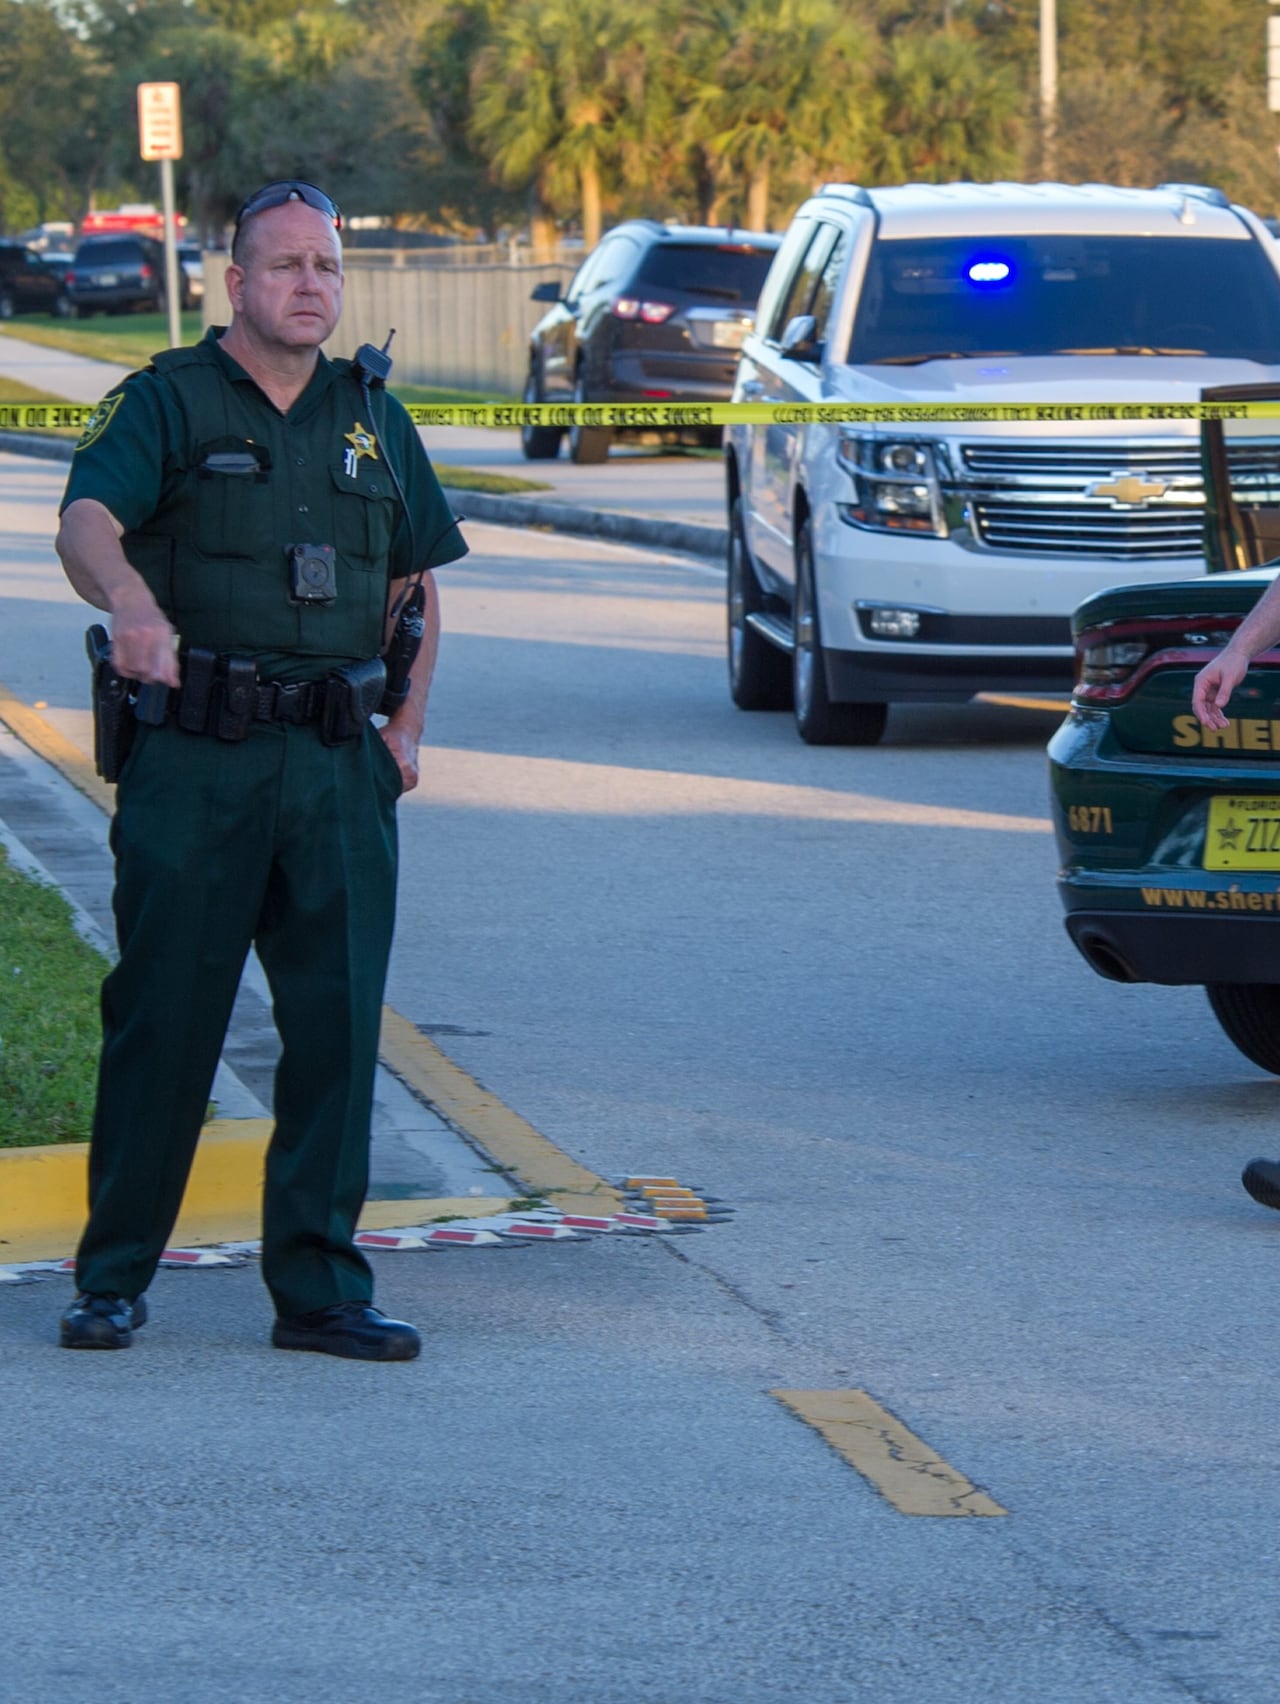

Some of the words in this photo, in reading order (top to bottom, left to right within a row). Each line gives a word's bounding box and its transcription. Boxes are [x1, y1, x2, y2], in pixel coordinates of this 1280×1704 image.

[494, 408, 542, 425] ENTER
[549, 408, 576, 425] NOT
[583, 408, 602, 425] DO
[608, 408, 657, 425] SCENE
[664, 408, 712, 425] CRIME
[1068, 805, 1113, 834] 6871
